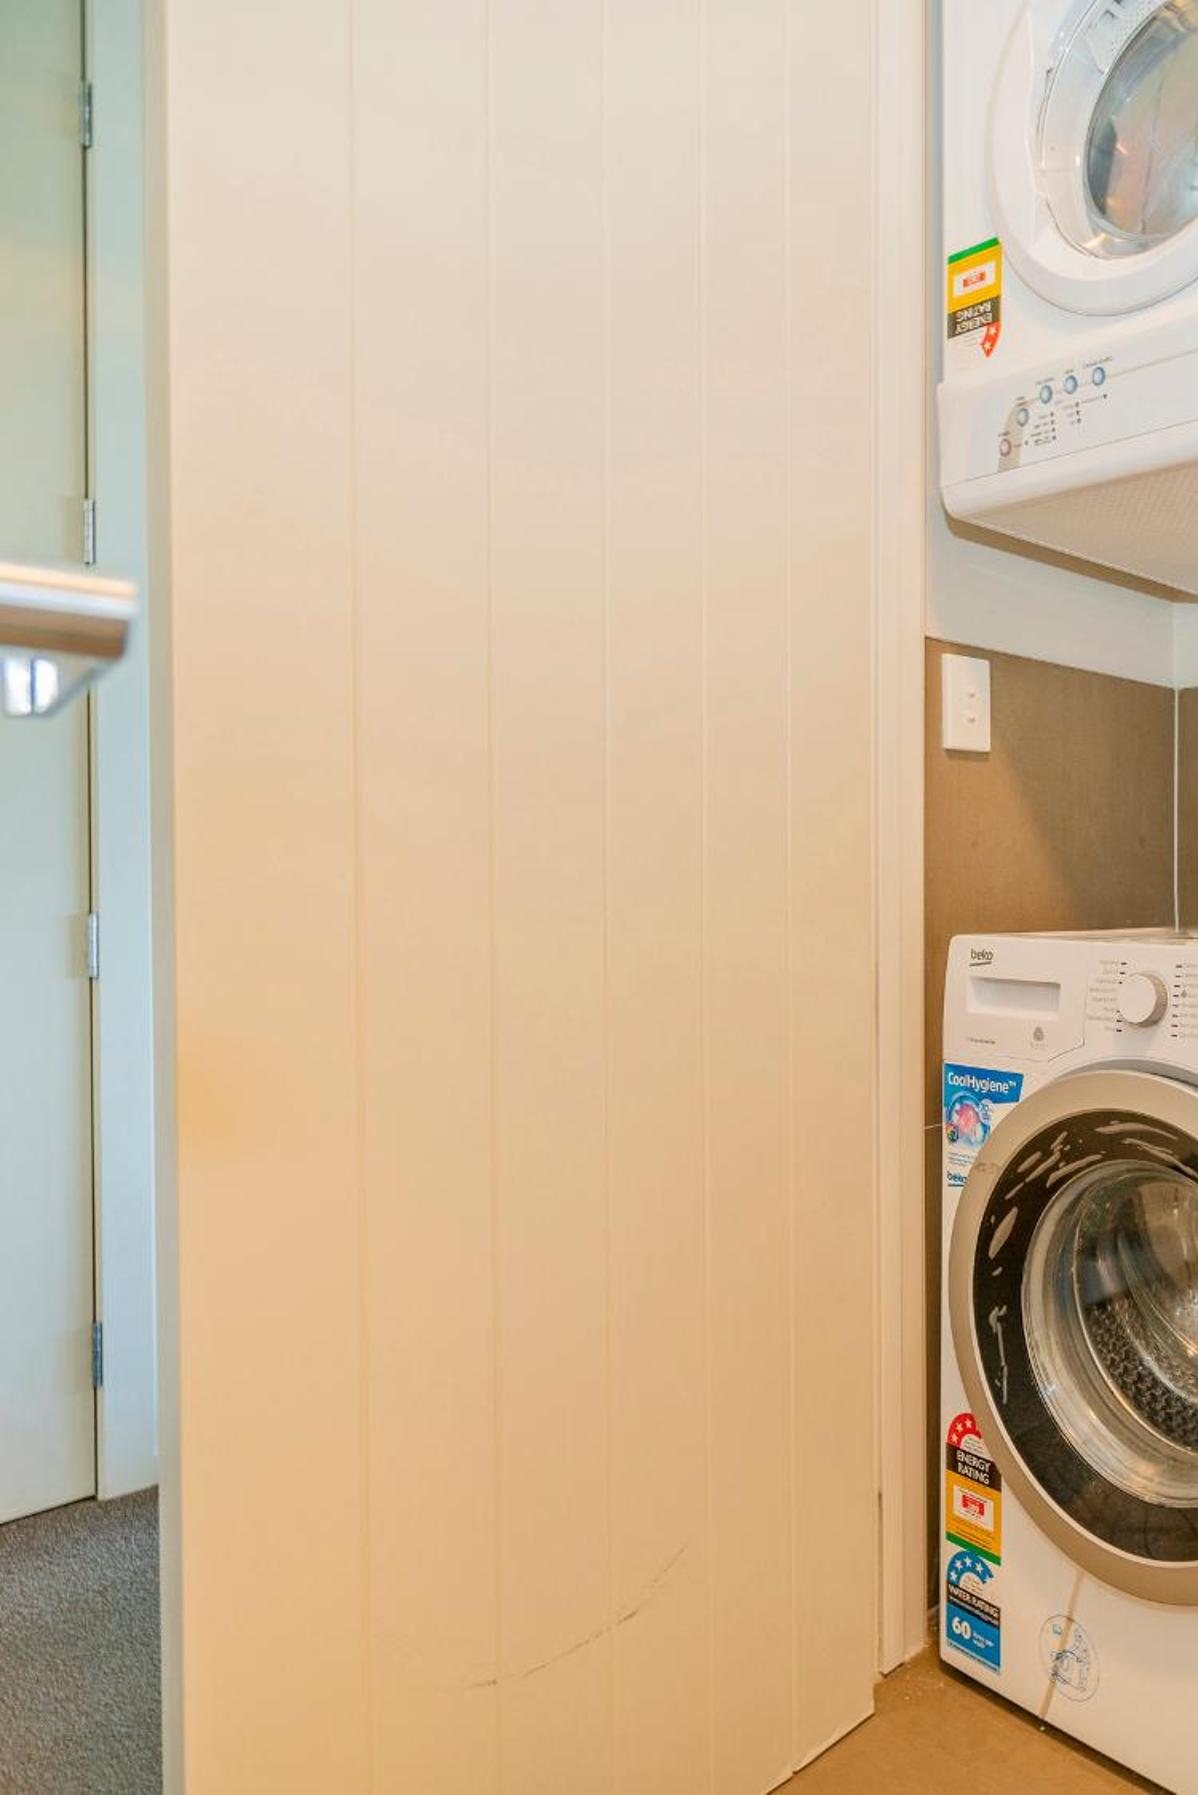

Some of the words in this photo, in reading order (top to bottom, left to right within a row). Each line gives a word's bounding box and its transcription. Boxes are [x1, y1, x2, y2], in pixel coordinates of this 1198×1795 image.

[971, 948, 994, 961] beko
[956, 1450, 992, 1472] ENERGY
[957, 1462, 990, 1485] RATING
[951, 1616, 972, 1640] 60
